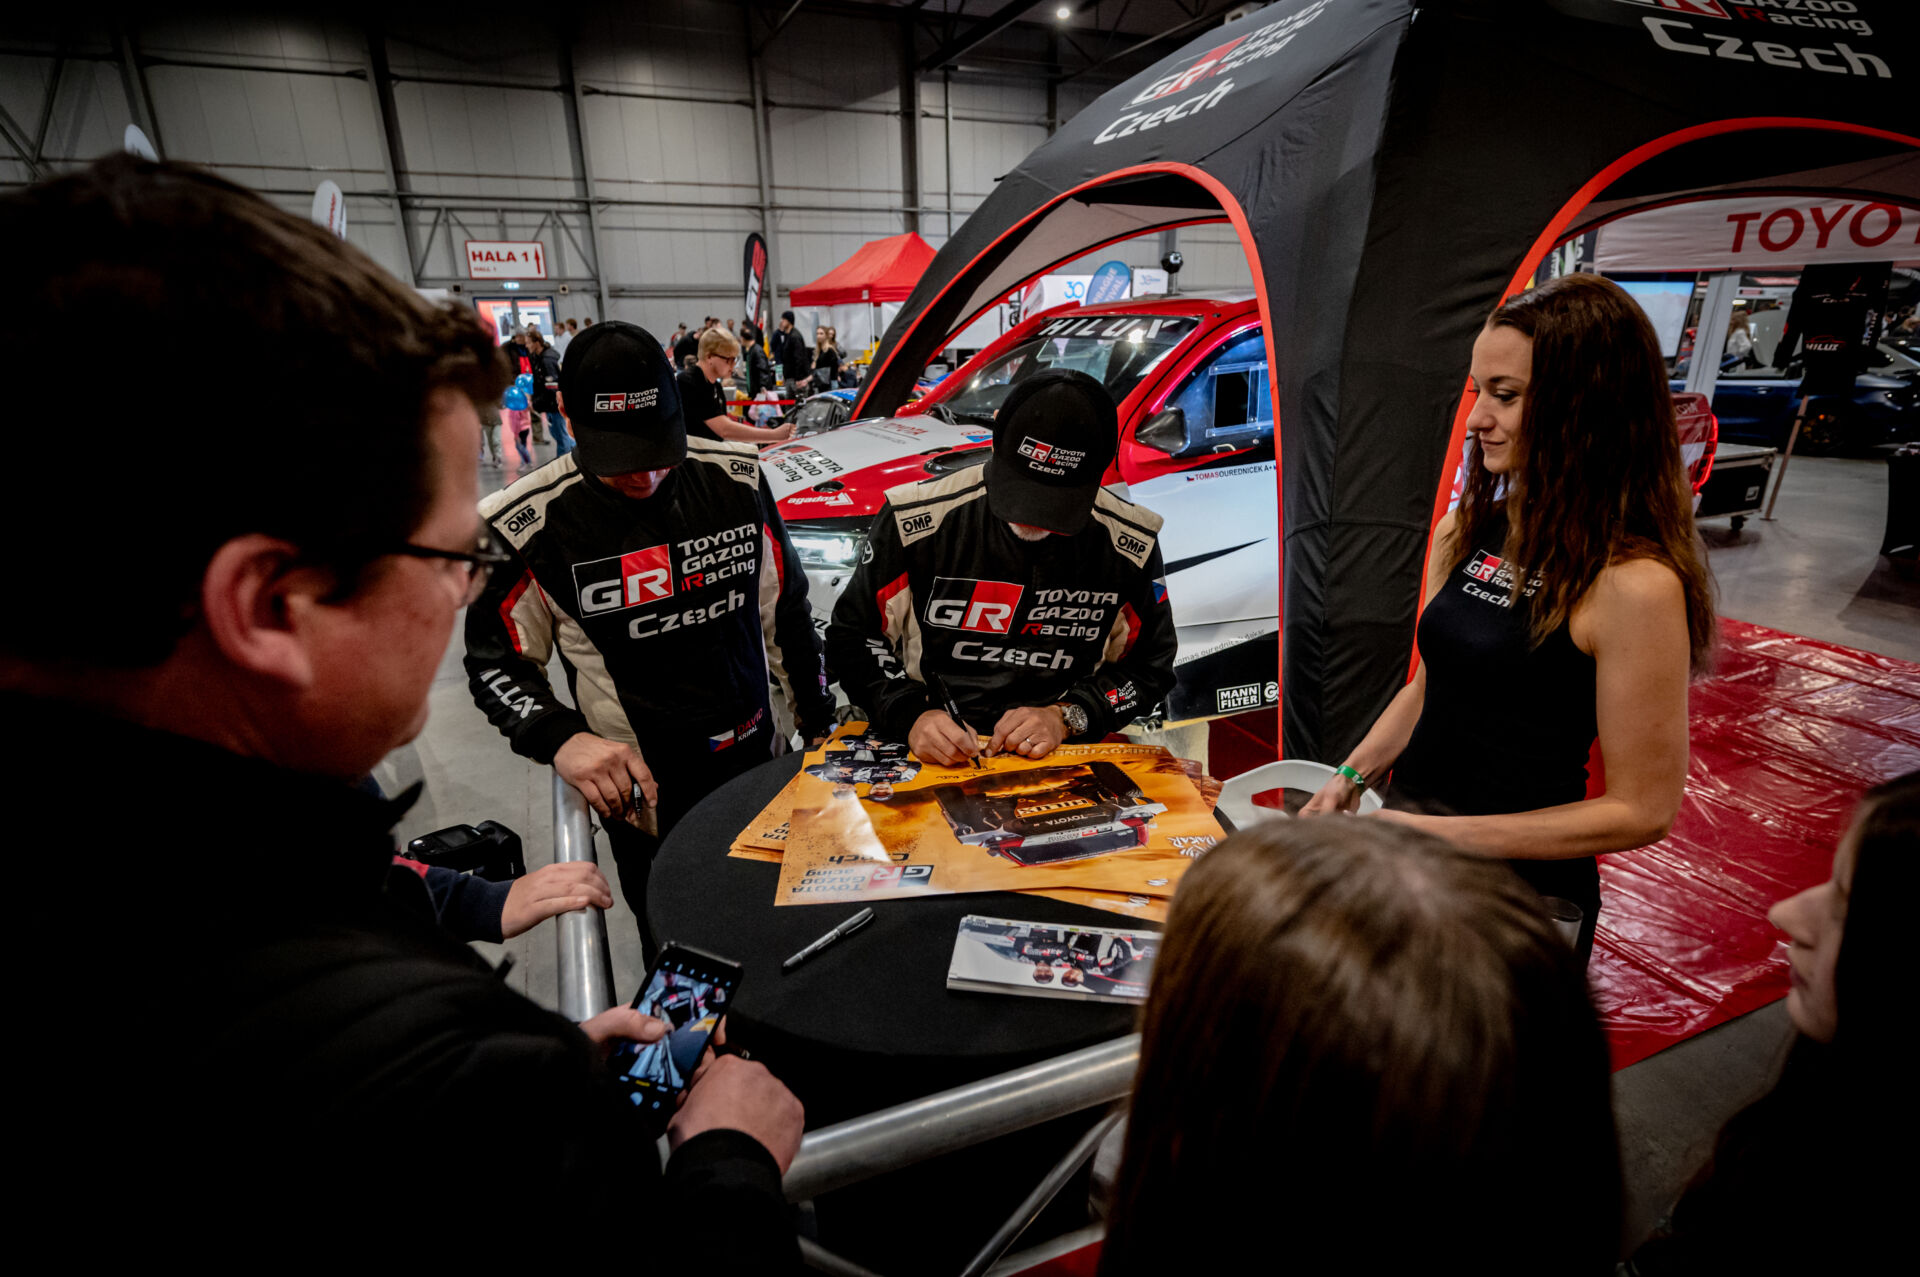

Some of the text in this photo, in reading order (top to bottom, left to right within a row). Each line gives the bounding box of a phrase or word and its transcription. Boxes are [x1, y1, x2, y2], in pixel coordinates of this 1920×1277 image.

[1246, 0, 1334, 43] TOYOT
[1735, 6, 1873, 36] Racing
[1642, 17, 1892, 78] Czech
[1201, 33, 1297, 82] Racing
[1131, 60, 1218, 104] GR
[1093, 78, 1235, 145] Czech
[1726, 202, 1920, 253] TOYO
[472, 250, 529, 262] HALA 1
[1064, 281, 1085, 299] 30
[1093, 267, 1118, 304] PRAGUE
[628, 387, 659, 398] TOYOTA
[628, 394, 657, 405] GAZOO
[596, 400, 625, 410] GR
[627, 400, 657, 410] Racing
[1021, 444, 1048, 460] GR
[1050, 453, 1081, 463] GAZOO
[1054, 448, 1086, 458] TOYOTA
[731, 461, 755, 475] OMP
[787, 454, 823, 477] GAZOO
[805, 449, 844, 474] TOOTA
[1029, 461, 1066, 476] Czech
[1048, 458, 1079, 469] Racing
[787, 495, 838, 505] agados
[508, 507, 537, 533] OMP
[902, 515, 933, 533] OMP
[677, 523, 757, 557] TOYOTA
[1117, 535, 1147, 554] OMP
[681, 541, 755, 575] GAZOO
[681, 558, 756, 592] Racing
[1466, 560, 1497, 579] GR
[580, 567, 670, 613] GR
[1035, 589, 1119, 605] TOYOTA
[1462, 582, 1511, 607] Czech
[628, 589, 746, 640] Czech
[928, 600, 1012, 631] GR
[1027, 606, 1105, 621] GAZOO
[1020, 622, 1100, 641] Racing
[951, 641, 1075, 669] Czech
[480, 668, 543, 719] ILUX
[1220, 686, 1258, 700] MANN
[1221, 695, 1258, 709] FILTER
[1115, 700, 1137, 714] zech
[1044, 813, 1085, 826] TOYOTA
[800, 876, 867, 886] GAZOO
[804, 868, 856, 878] acing
[874, 866, 932, 882] GR
[791, 883, 863, 894] TOYOTA
